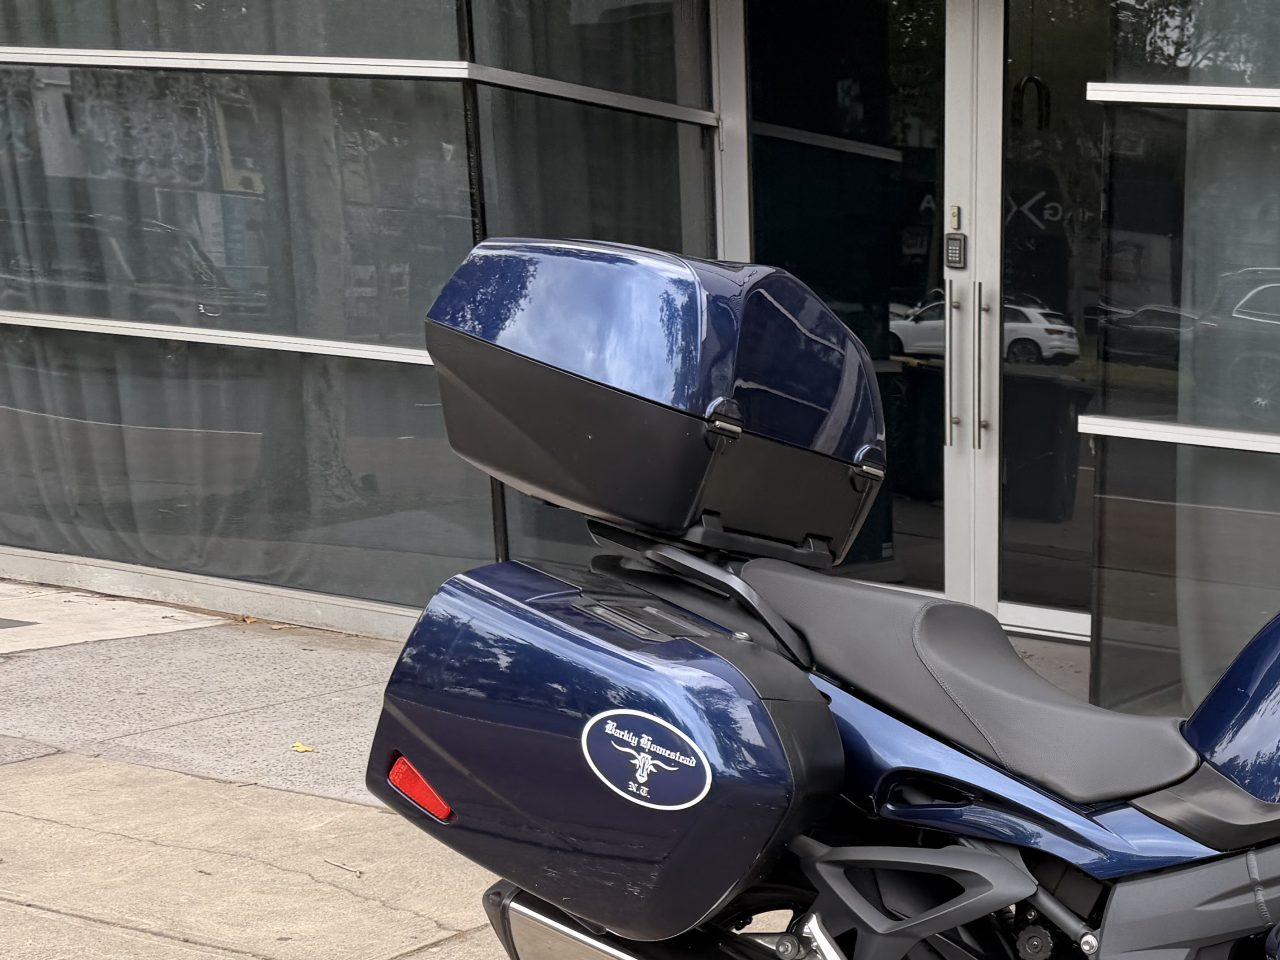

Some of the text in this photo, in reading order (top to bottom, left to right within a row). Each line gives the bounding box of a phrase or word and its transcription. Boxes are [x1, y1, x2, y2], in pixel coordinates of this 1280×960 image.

[605, 720, 696, 767] Barkly Homestead
[628, 781, 650, 797] N.T.
